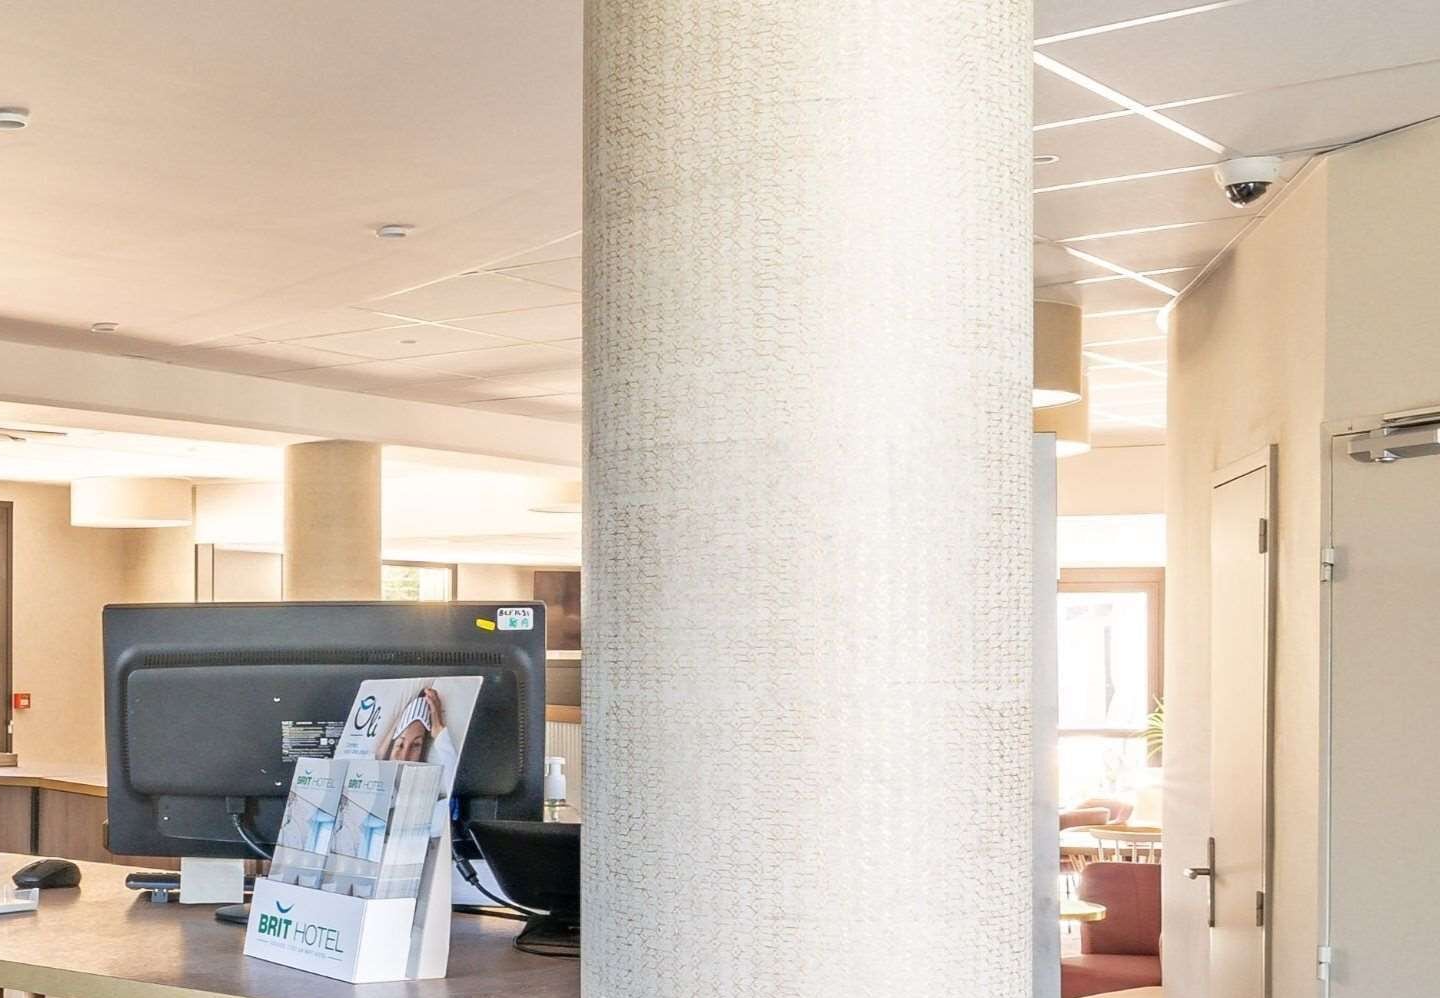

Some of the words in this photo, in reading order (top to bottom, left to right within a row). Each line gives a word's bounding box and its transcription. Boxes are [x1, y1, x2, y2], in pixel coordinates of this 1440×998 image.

[296, 775, 312, 786] BRIT
[313, 777, 336, 789] HOTEL
[348, 779, 363, 789] BRIT
[364, 780, 386, 792] HOTEL
[258, 913, 292, 940] BRIT
[294, 922, 344, 953] HOTEL
